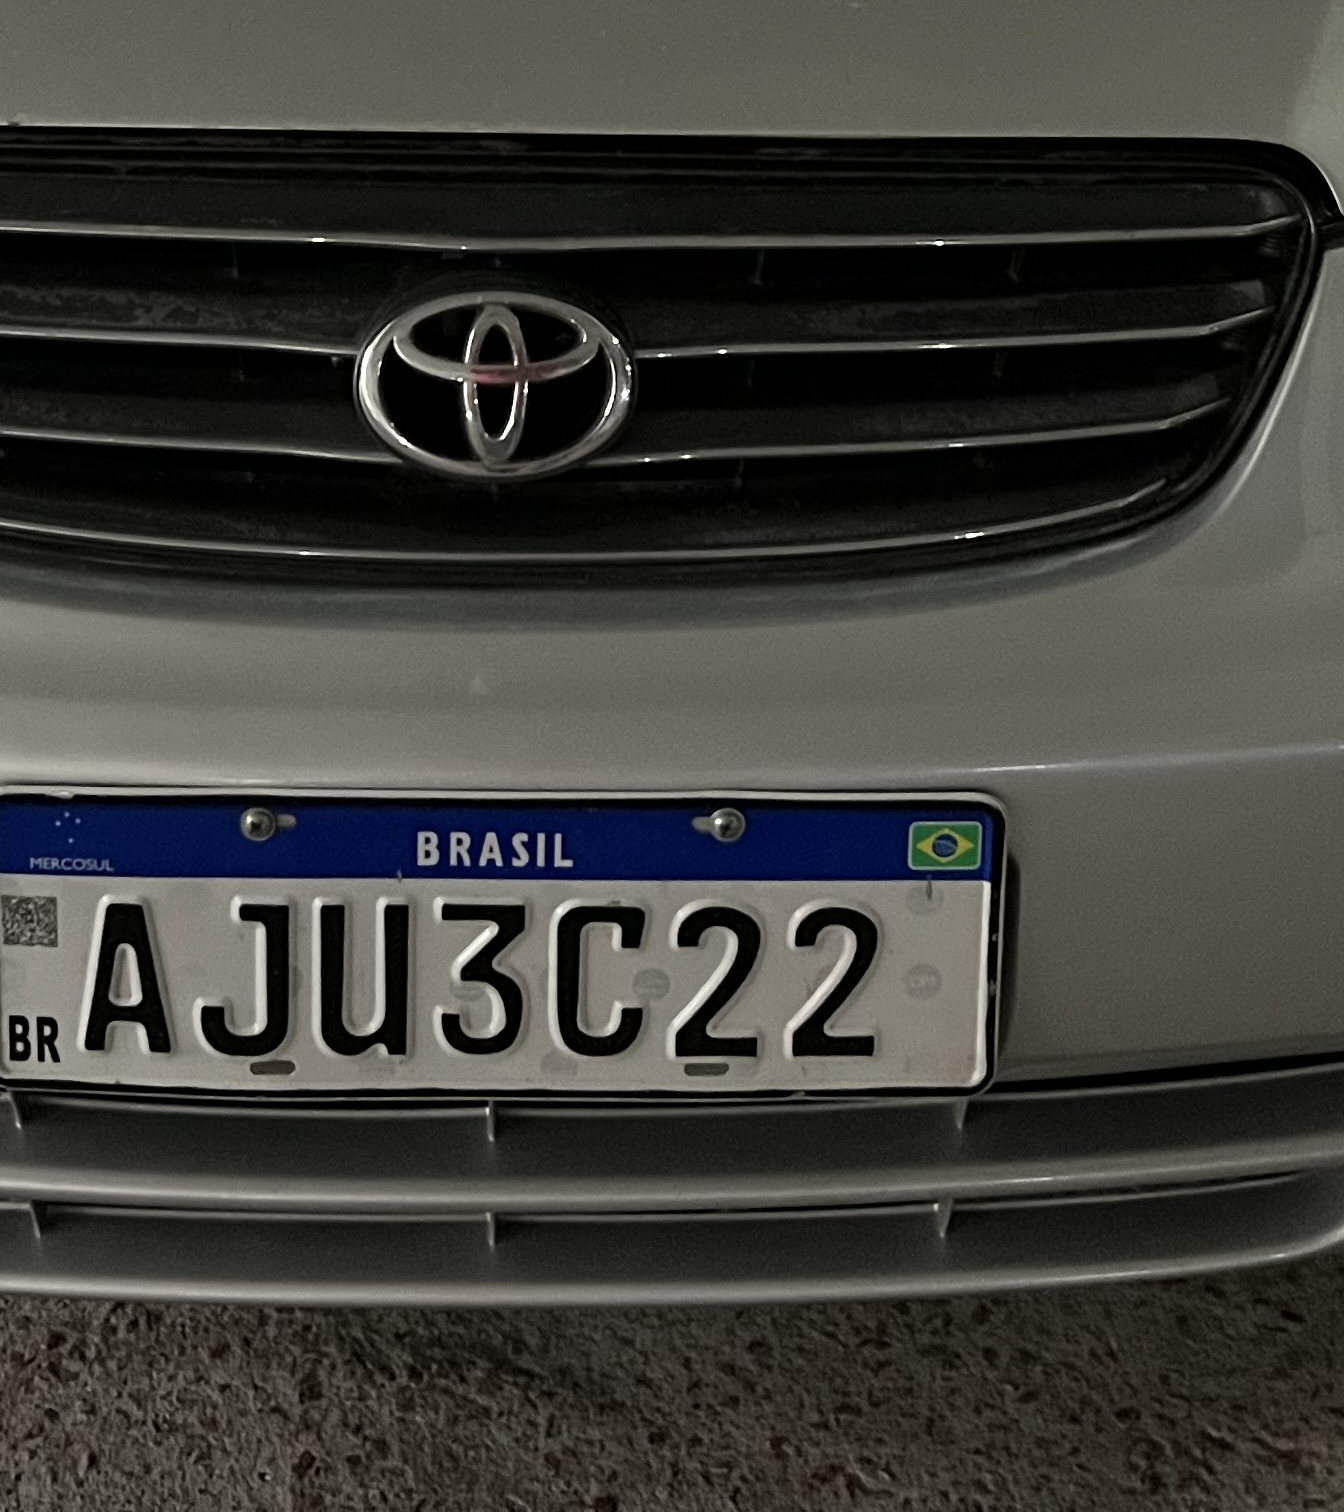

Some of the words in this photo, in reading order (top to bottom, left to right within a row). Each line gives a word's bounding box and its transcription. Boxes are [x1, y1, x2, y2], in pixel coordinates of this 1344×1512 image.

[29, 856, 115, 872] MERCOSUL
[416, 830, 574, 868] BRASIL
[83, 902, 879, 1057] AJU3C22
[8, 1014, 61, 1063] BR
